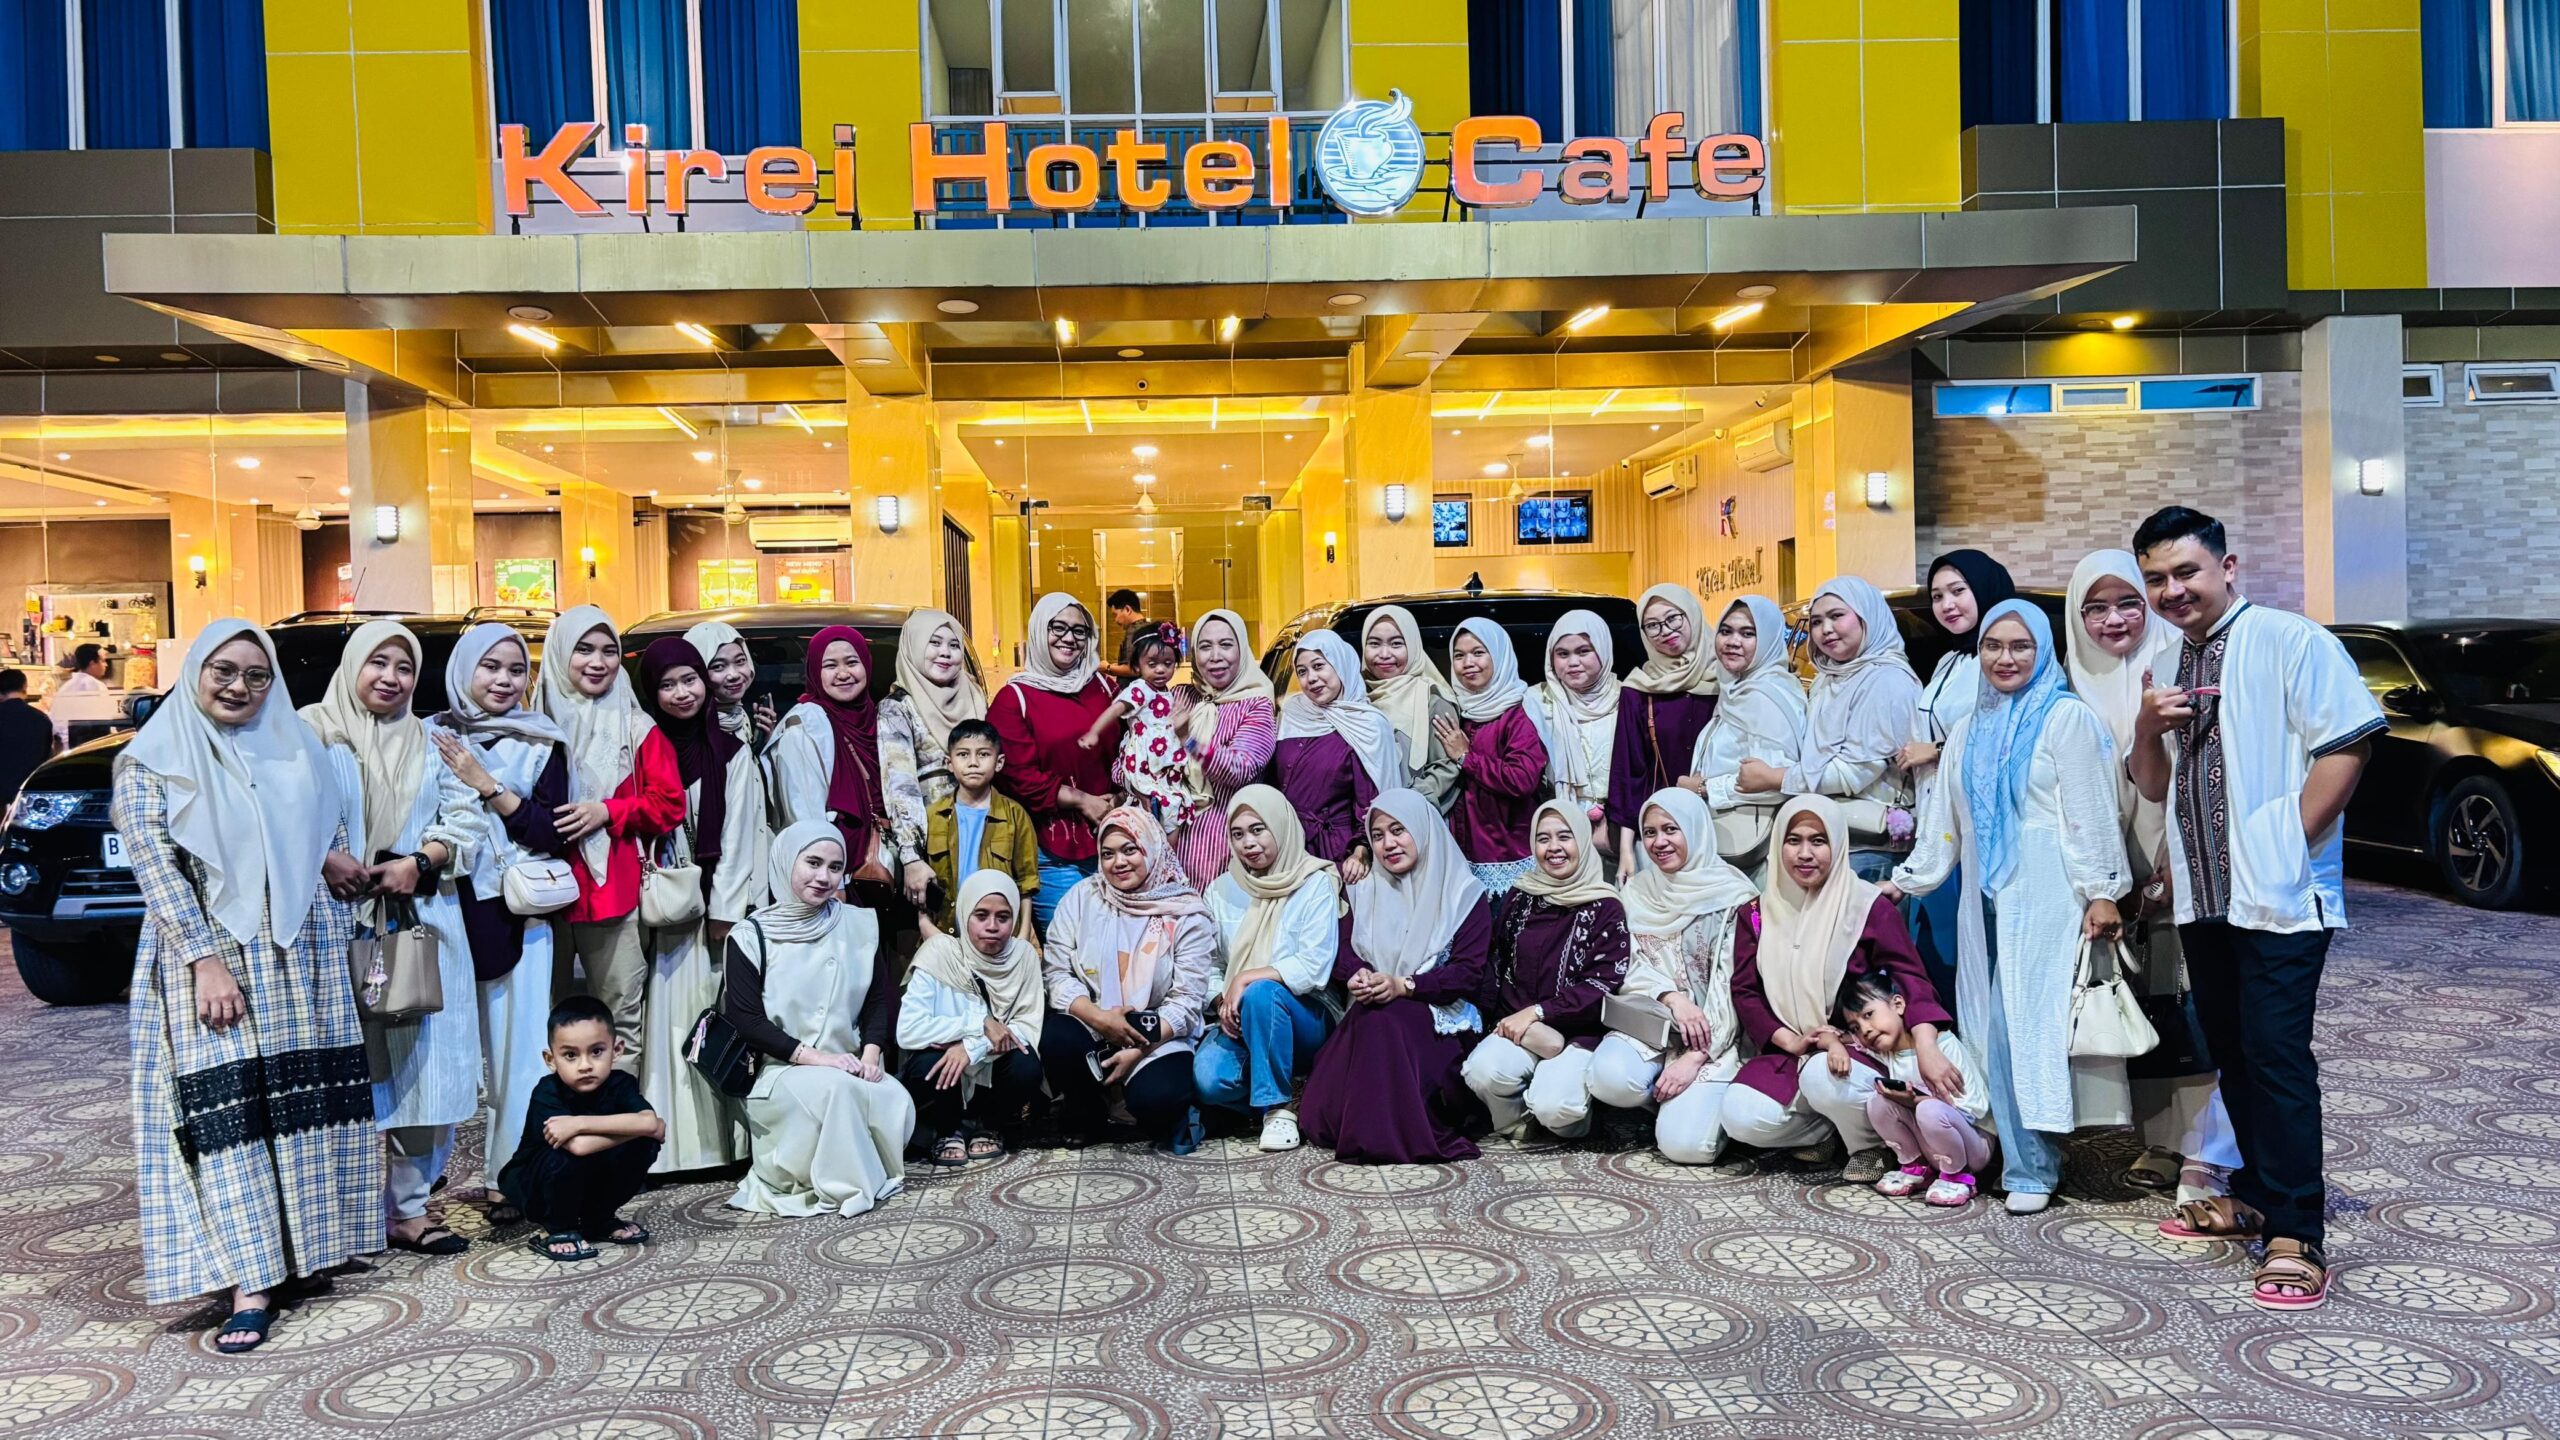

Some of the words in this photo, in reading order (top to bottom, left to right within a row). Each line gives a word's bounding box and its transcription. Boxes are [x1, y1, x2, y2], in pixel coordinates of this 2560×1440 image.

[500, 122, 858, 218] Kirei
[909, 116, 1292, 215] Hotel
[1450, 112, 1766, 208] Cafe
[108, 837, 119, 855] B
